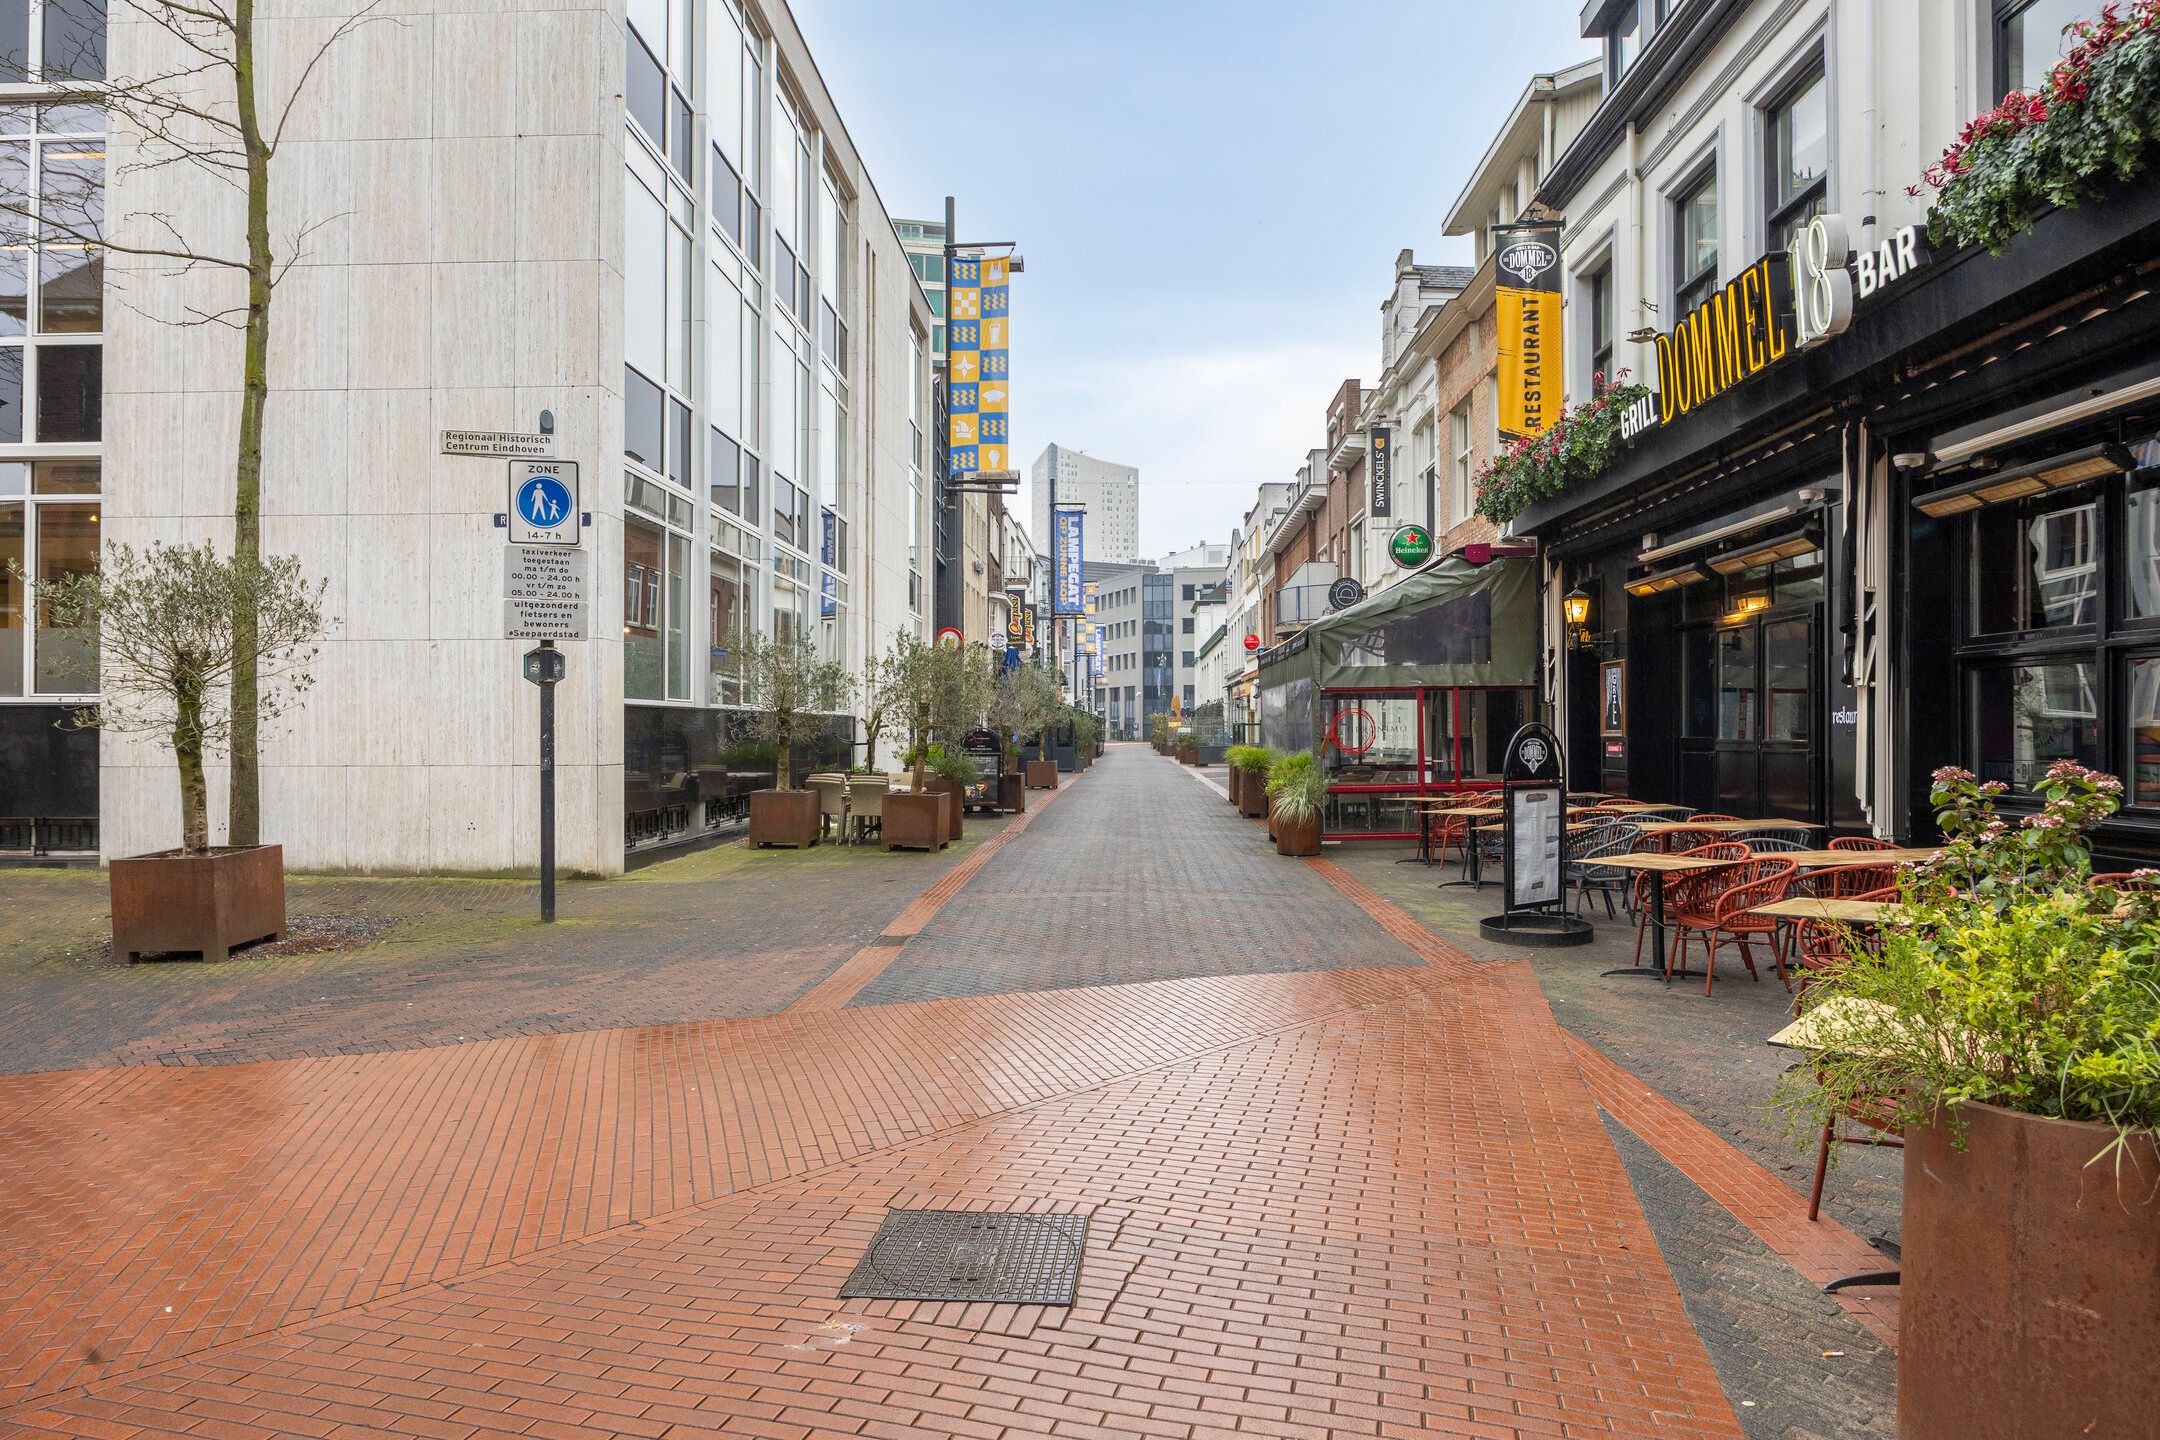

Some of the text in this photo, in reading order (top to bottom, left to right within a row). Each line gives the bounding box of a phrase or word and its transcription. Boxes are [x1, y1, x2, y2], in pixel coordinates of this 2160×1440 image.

[1509, 250, 1547, 269] DOMMEL
[1524, 267, 1533, 280] 18
[1620, 214, 1922, 440] GRILL DOMMEL 18 BAR
[1522, 297, 1541, 429] RESTAURANT
[445, 432, 551, 444] Regionaal Historisch
[446, 442, 545, 454] Centrum Eindhoven
[528, 465, 560, 474] ZONE
[1060, 516, 1067, 534] OP
[527, 531, 562, 540] 14-7 h
[522, 548, 572, 557] taxiverkeer
[523, 557, 570, 565] toegestaan
[1068, 516, 1080, 606] LAMPEGAT
[511, 589, 537, 597] 05.00
[547, 591, 573, 599] 24.00
[1060, 579, 1068, 606] KOP
[514, 601, 579, 610] uitgezonderd
[520, 610, 558, 618] fietsers
[524, 620, 569, 628] bewoners
